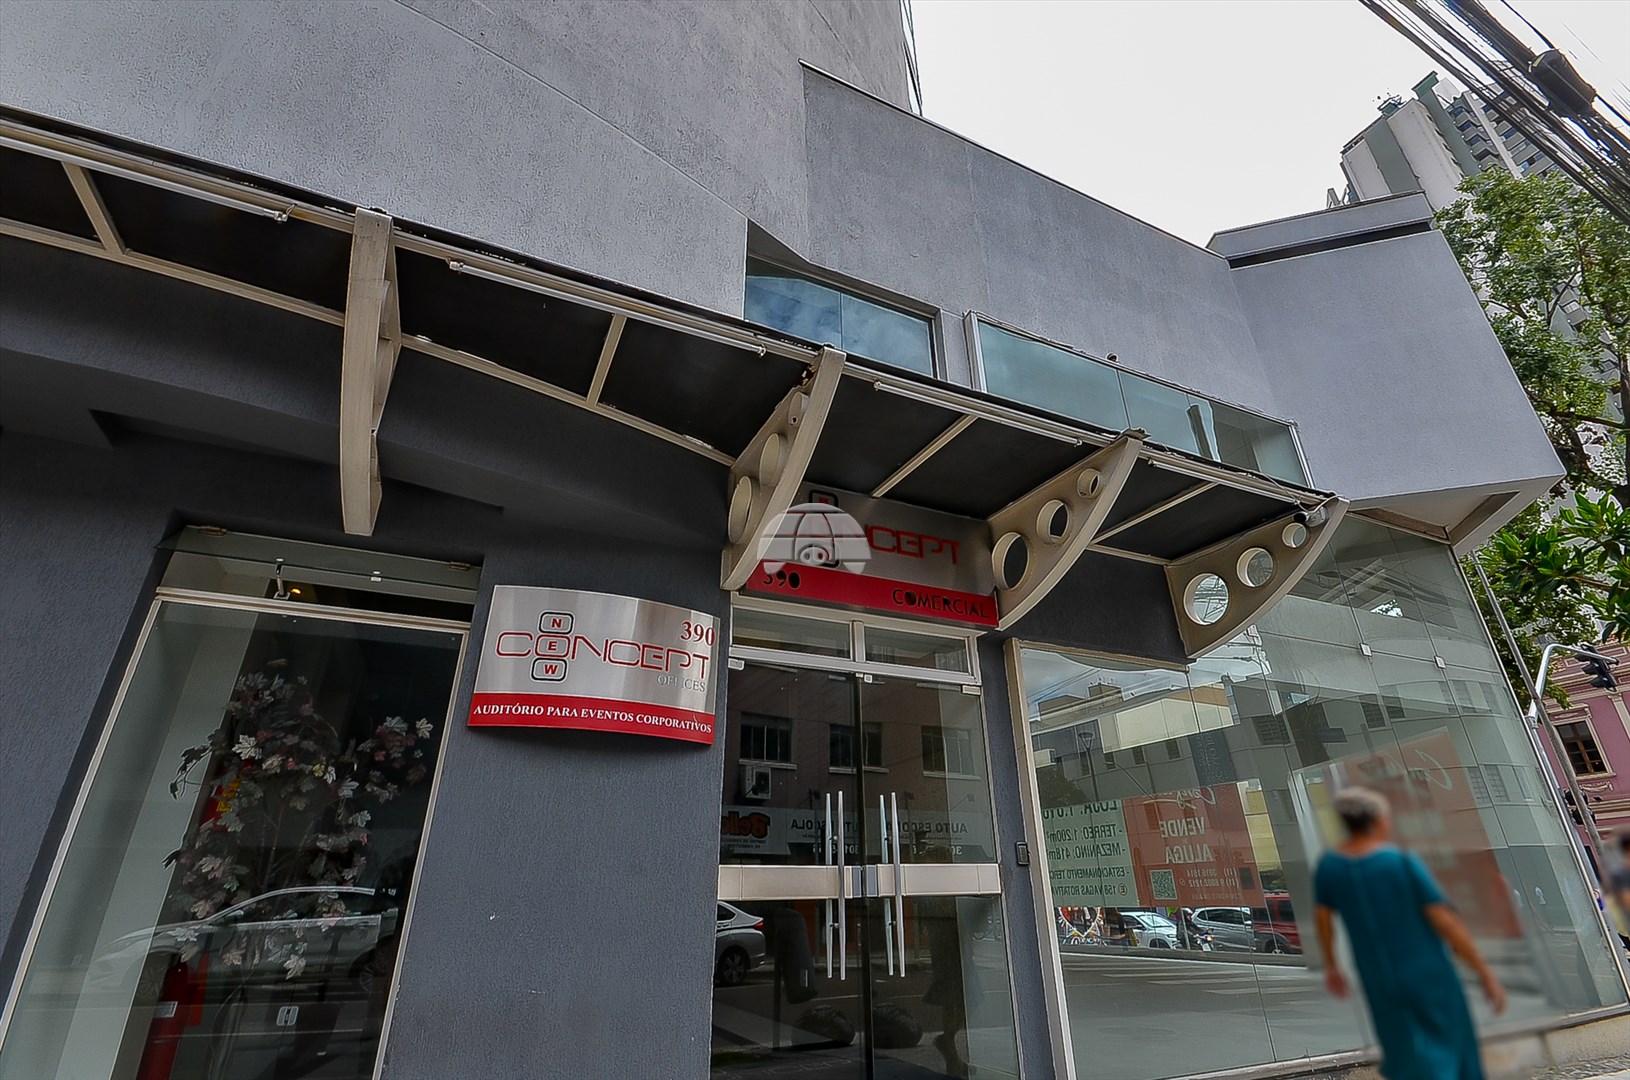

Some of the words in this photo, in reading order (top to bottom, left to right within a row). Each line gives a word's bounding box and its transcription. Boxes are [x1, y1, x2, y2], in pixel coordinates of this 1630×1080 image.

[892, 588, 989, 618] COMERCIAL
[680, 620, 715, 646] 390
[496, 631, 709, 679] CONCEPT
[473, 702, 544, 716] AUDITÓRIO
[546, 705, 579, 718] PARA
[580, 708, 634, 723] EVENTOS
[635, 712, 712, 734] CORPORATIVOS
